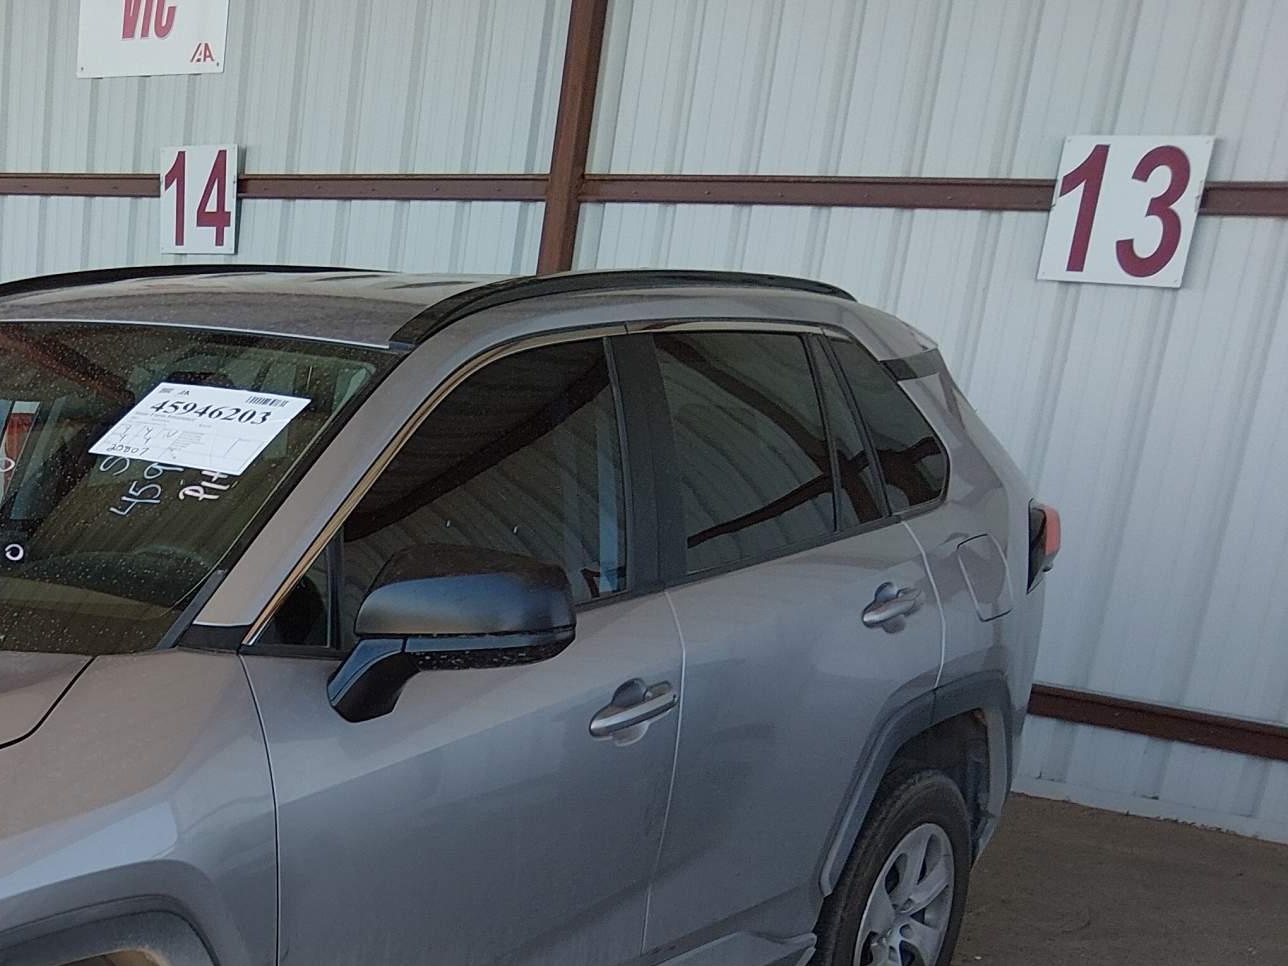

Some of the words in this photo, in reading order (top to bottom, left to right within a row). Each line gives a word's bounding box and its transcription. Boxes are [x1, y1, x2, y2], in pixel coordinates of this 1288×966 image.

[121, 0, 177, 39] VIC
[165, 149, 231, 246] 14
[1059, 144, 1190, 277] 13
[149, 399, 272, 425] 45946203
